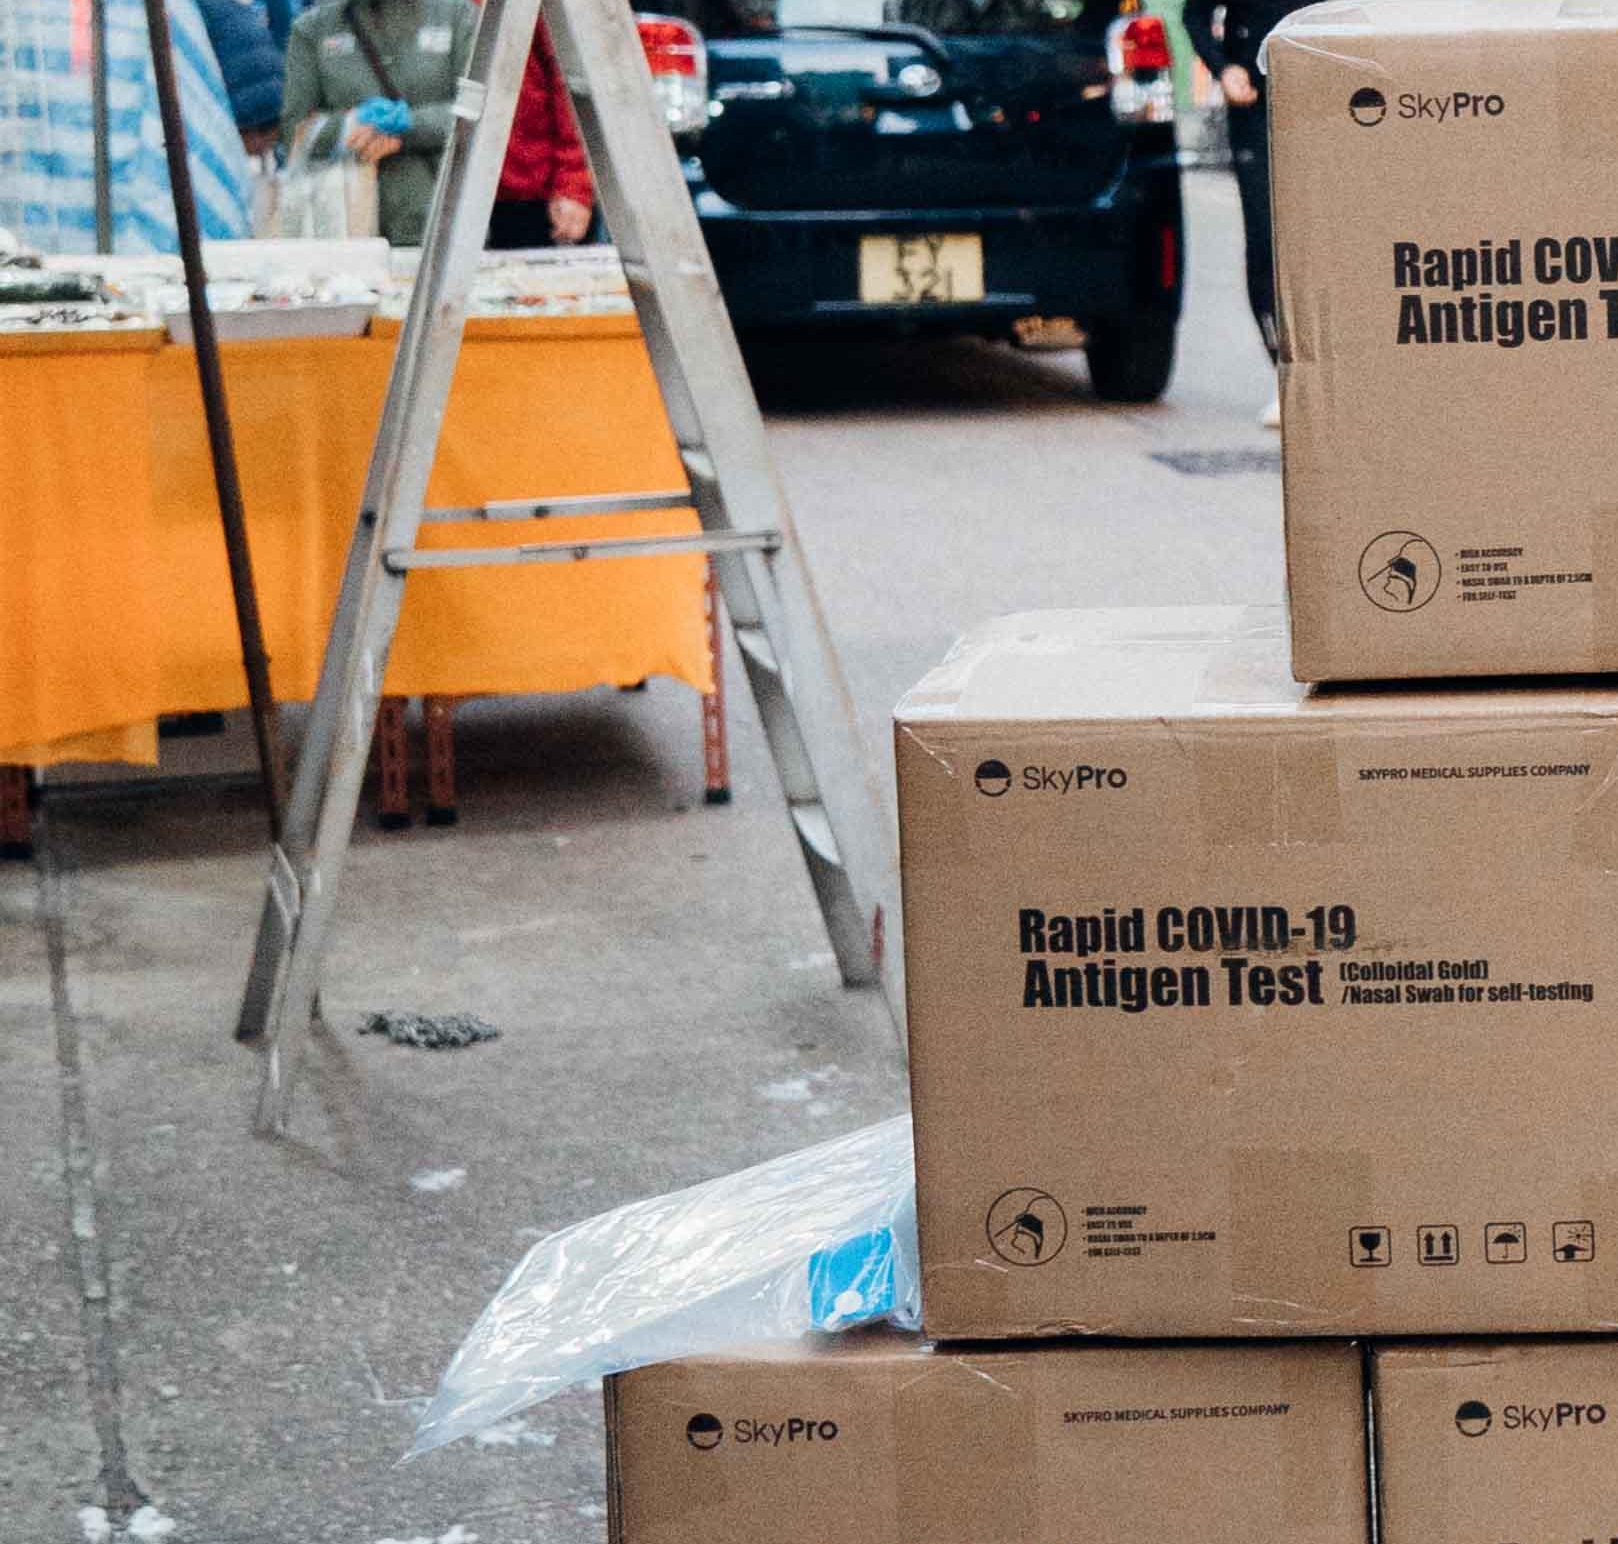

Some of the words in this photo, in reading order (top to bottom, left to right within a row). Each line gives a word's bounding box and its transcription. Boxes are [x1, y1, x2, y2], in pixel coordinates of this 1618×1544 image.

[1398, 92, 1504, 123] SkyPro
[1394, 240, 1521, 291] Rapid
[1397, 293, 1588, 348] Antigen
[1022, 765, 1127, 795] SkyPro
[1358, 767, 1406, 780] SKYPRO
[1410, 765, 1465, 779] MEDICAL
[1468, 764, 1527, 779] SUPPLIES
[1529, 764, 1590, 776] COMPANY
[1019, 908, 1145, 958] Rapid
[1156, 904, 1356, 952] COVID-19
[1022, 960, 1211, 1014] Antigen
[1222, 958, 1325, 1006] Test
[1403, 984, 1455, 1004] Swab
[1458, 984, 1483, 1003] for
[733, 1418, 838, 1447] SkyPro
[1502, 1403, 1606, 1432] SkyPro
